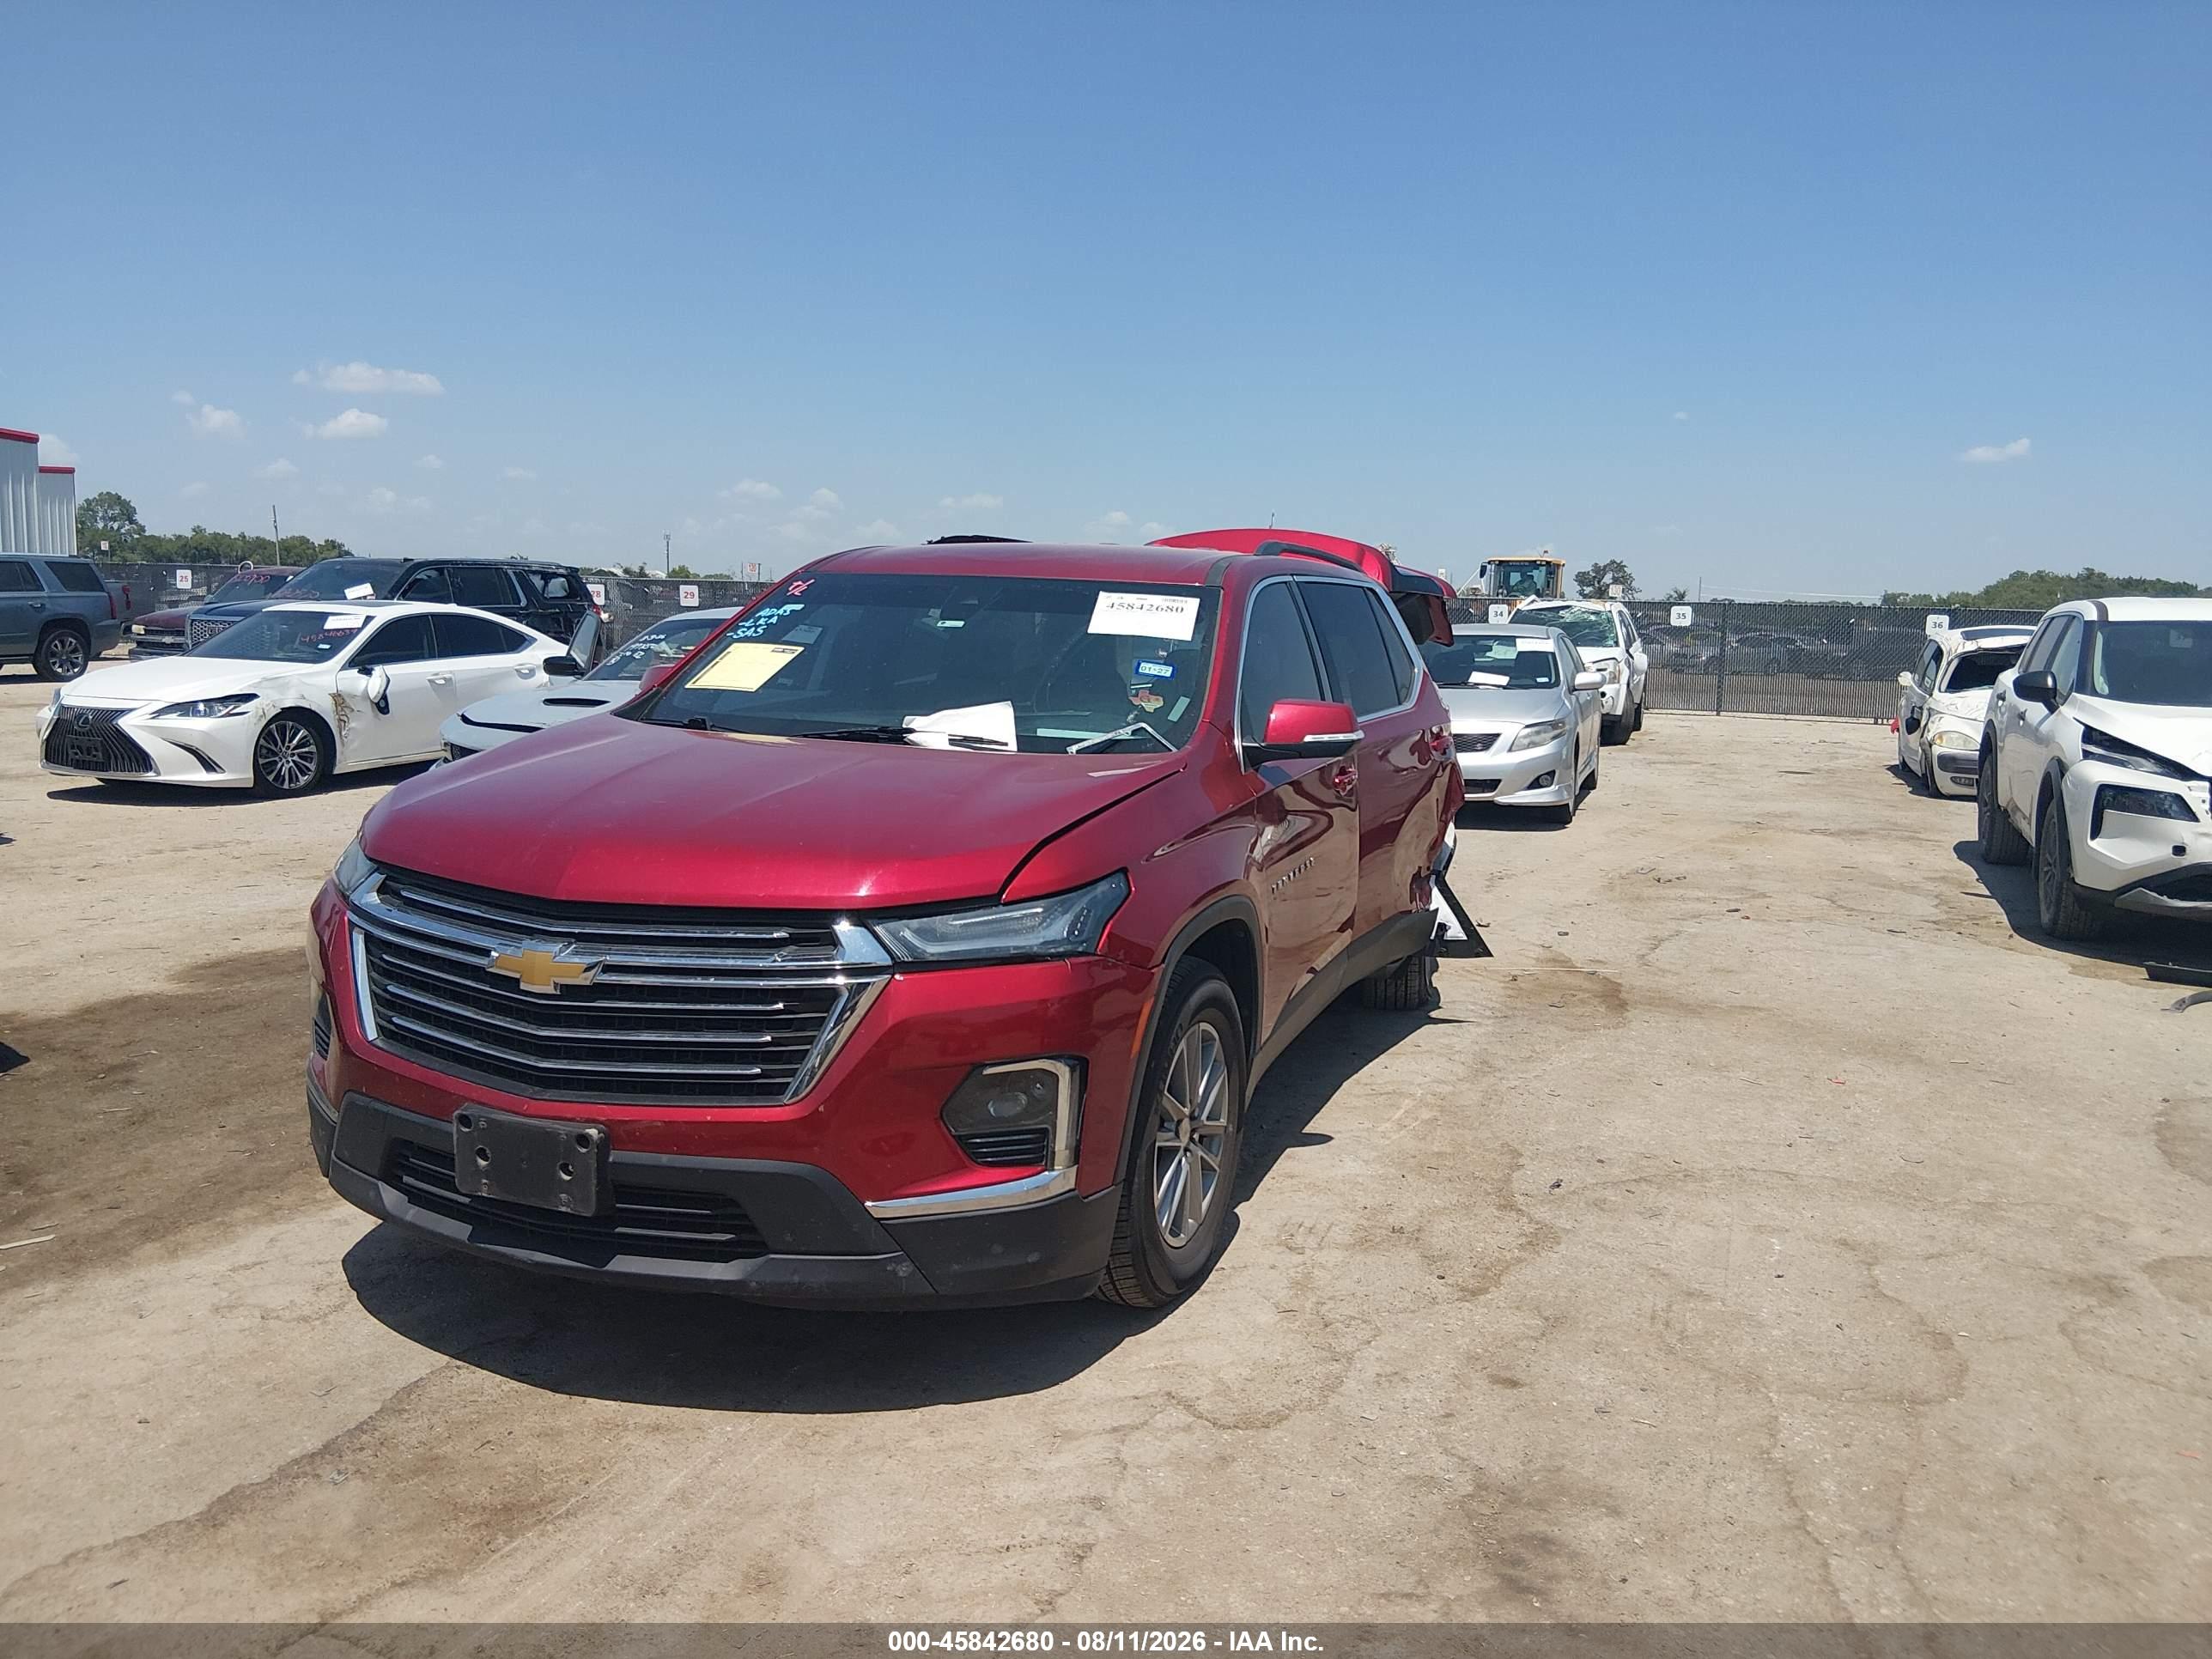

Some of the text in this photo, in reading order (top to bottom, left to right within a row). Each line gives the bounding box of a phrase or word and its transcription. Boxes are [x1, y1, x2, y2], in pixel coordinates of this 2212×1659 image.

[591, 590, 601, 599] 28
[683, 591, 696, 599] 29
[755, 605, 792, 617] ADAS
[1105, 601, 1184, 613] 45842680
[1930, 621, 1944, 629] 36
